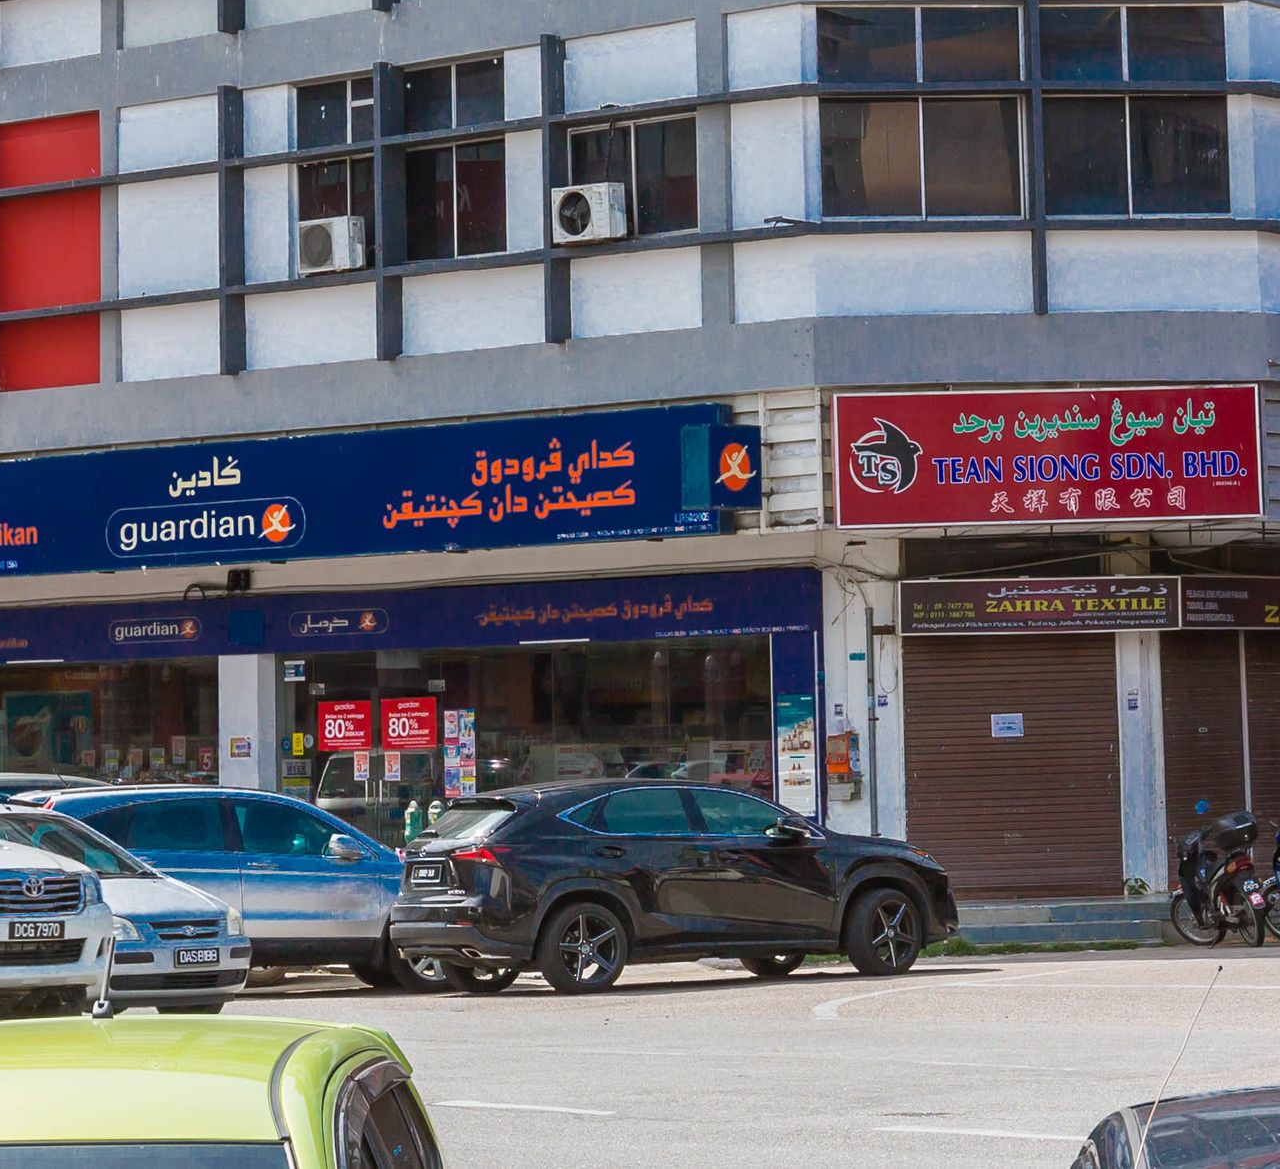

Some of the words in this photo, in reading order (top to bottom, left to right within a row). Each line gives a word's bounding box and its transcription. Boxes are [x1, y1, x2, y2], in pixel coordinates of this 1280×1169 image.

[1173, 397, 1216, 434] تيان
[858, 451, 898, 485] TS
[932, 456, 1004, 485] TEAN
[1013, 452, 1101, 483] SIONG
[1110, 451, 1173, 480] SDN.
[1182, 449, 1247, 478] BHD.
[119, 510, 255, 552] guardian
[986, 599, 1065, 613] ZAHRA
[1072, 597, 1166, 611] TEXTILE
[115, 622, 179, 642] guardian
